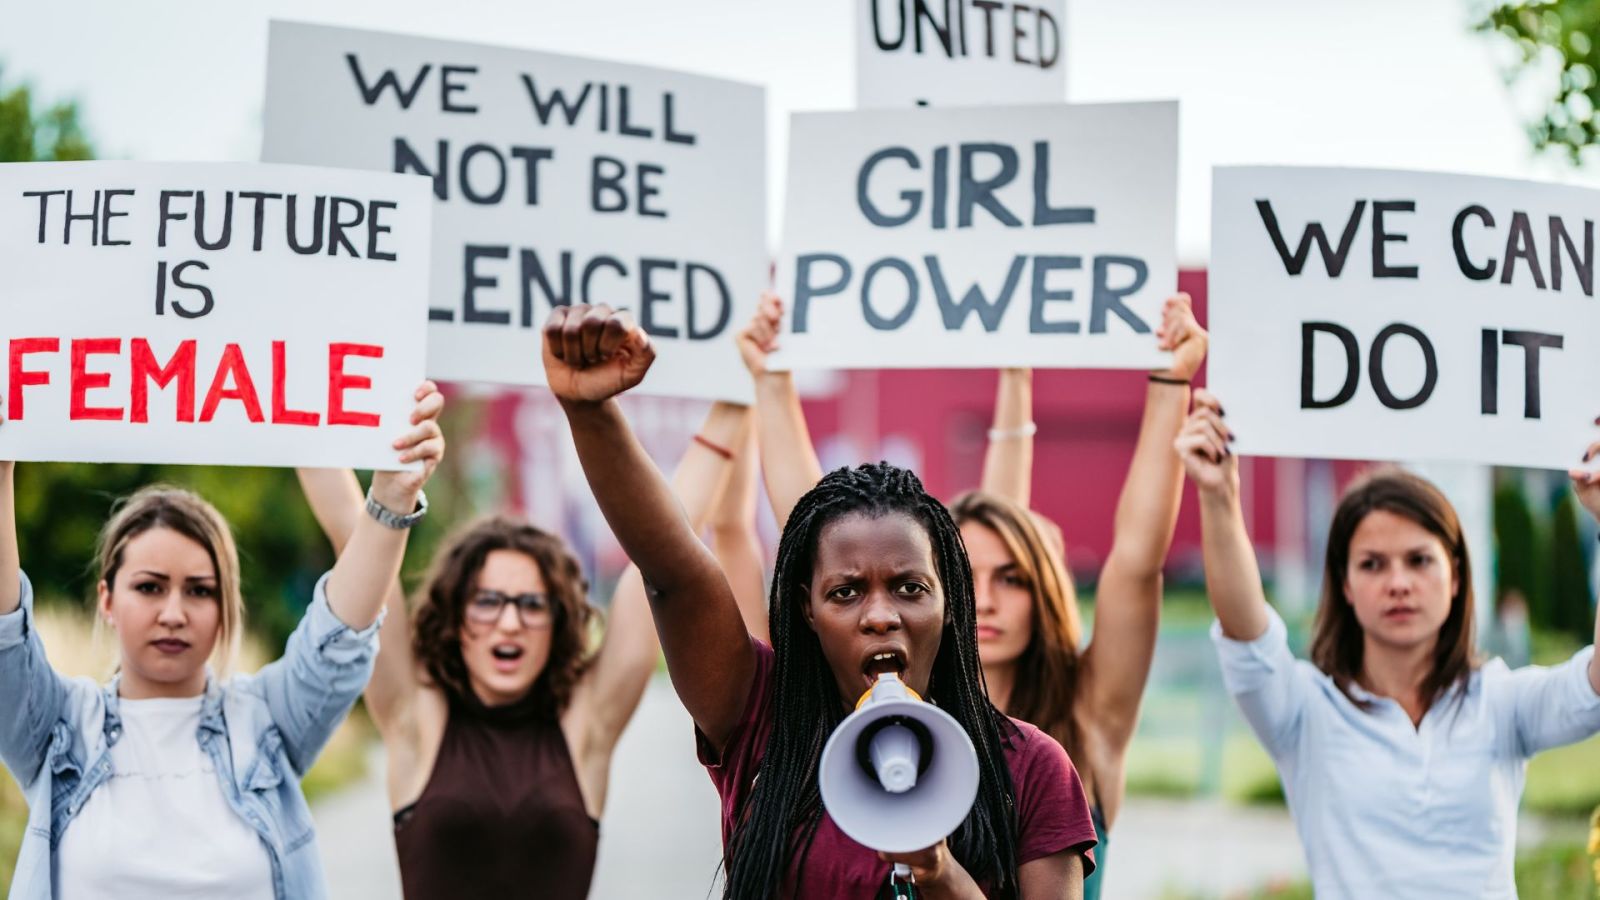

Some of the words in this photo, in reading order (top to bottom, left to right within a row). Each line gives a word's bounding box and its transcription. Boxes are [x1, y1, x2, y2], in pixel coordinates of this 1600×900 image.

[870, 0, 1060, 69] UNITED
[344, 52, 479, 115] WE
[520, 73, 697, 146] WILL
[393, 136, 554, 206] NOT
[590, 155, 668, 219] BE
[856, 140, 1096, 230] GIRL
[22, 189, 135, 247] THE
[157, 189, 398, 262] FUTURE
[1254, 198, 1420, 280] WE
[1451, 204, 1595, 298] CAN
[155, 259, 215, 320] IS
[429, 243, 732, 342] ENCED
[791, 253, 1151, 335] POWER
[7, 337, 385, 428] FEMALE
[1299, 320, 1439, 411] DO
[1480, 327, 1564, 420] IT
